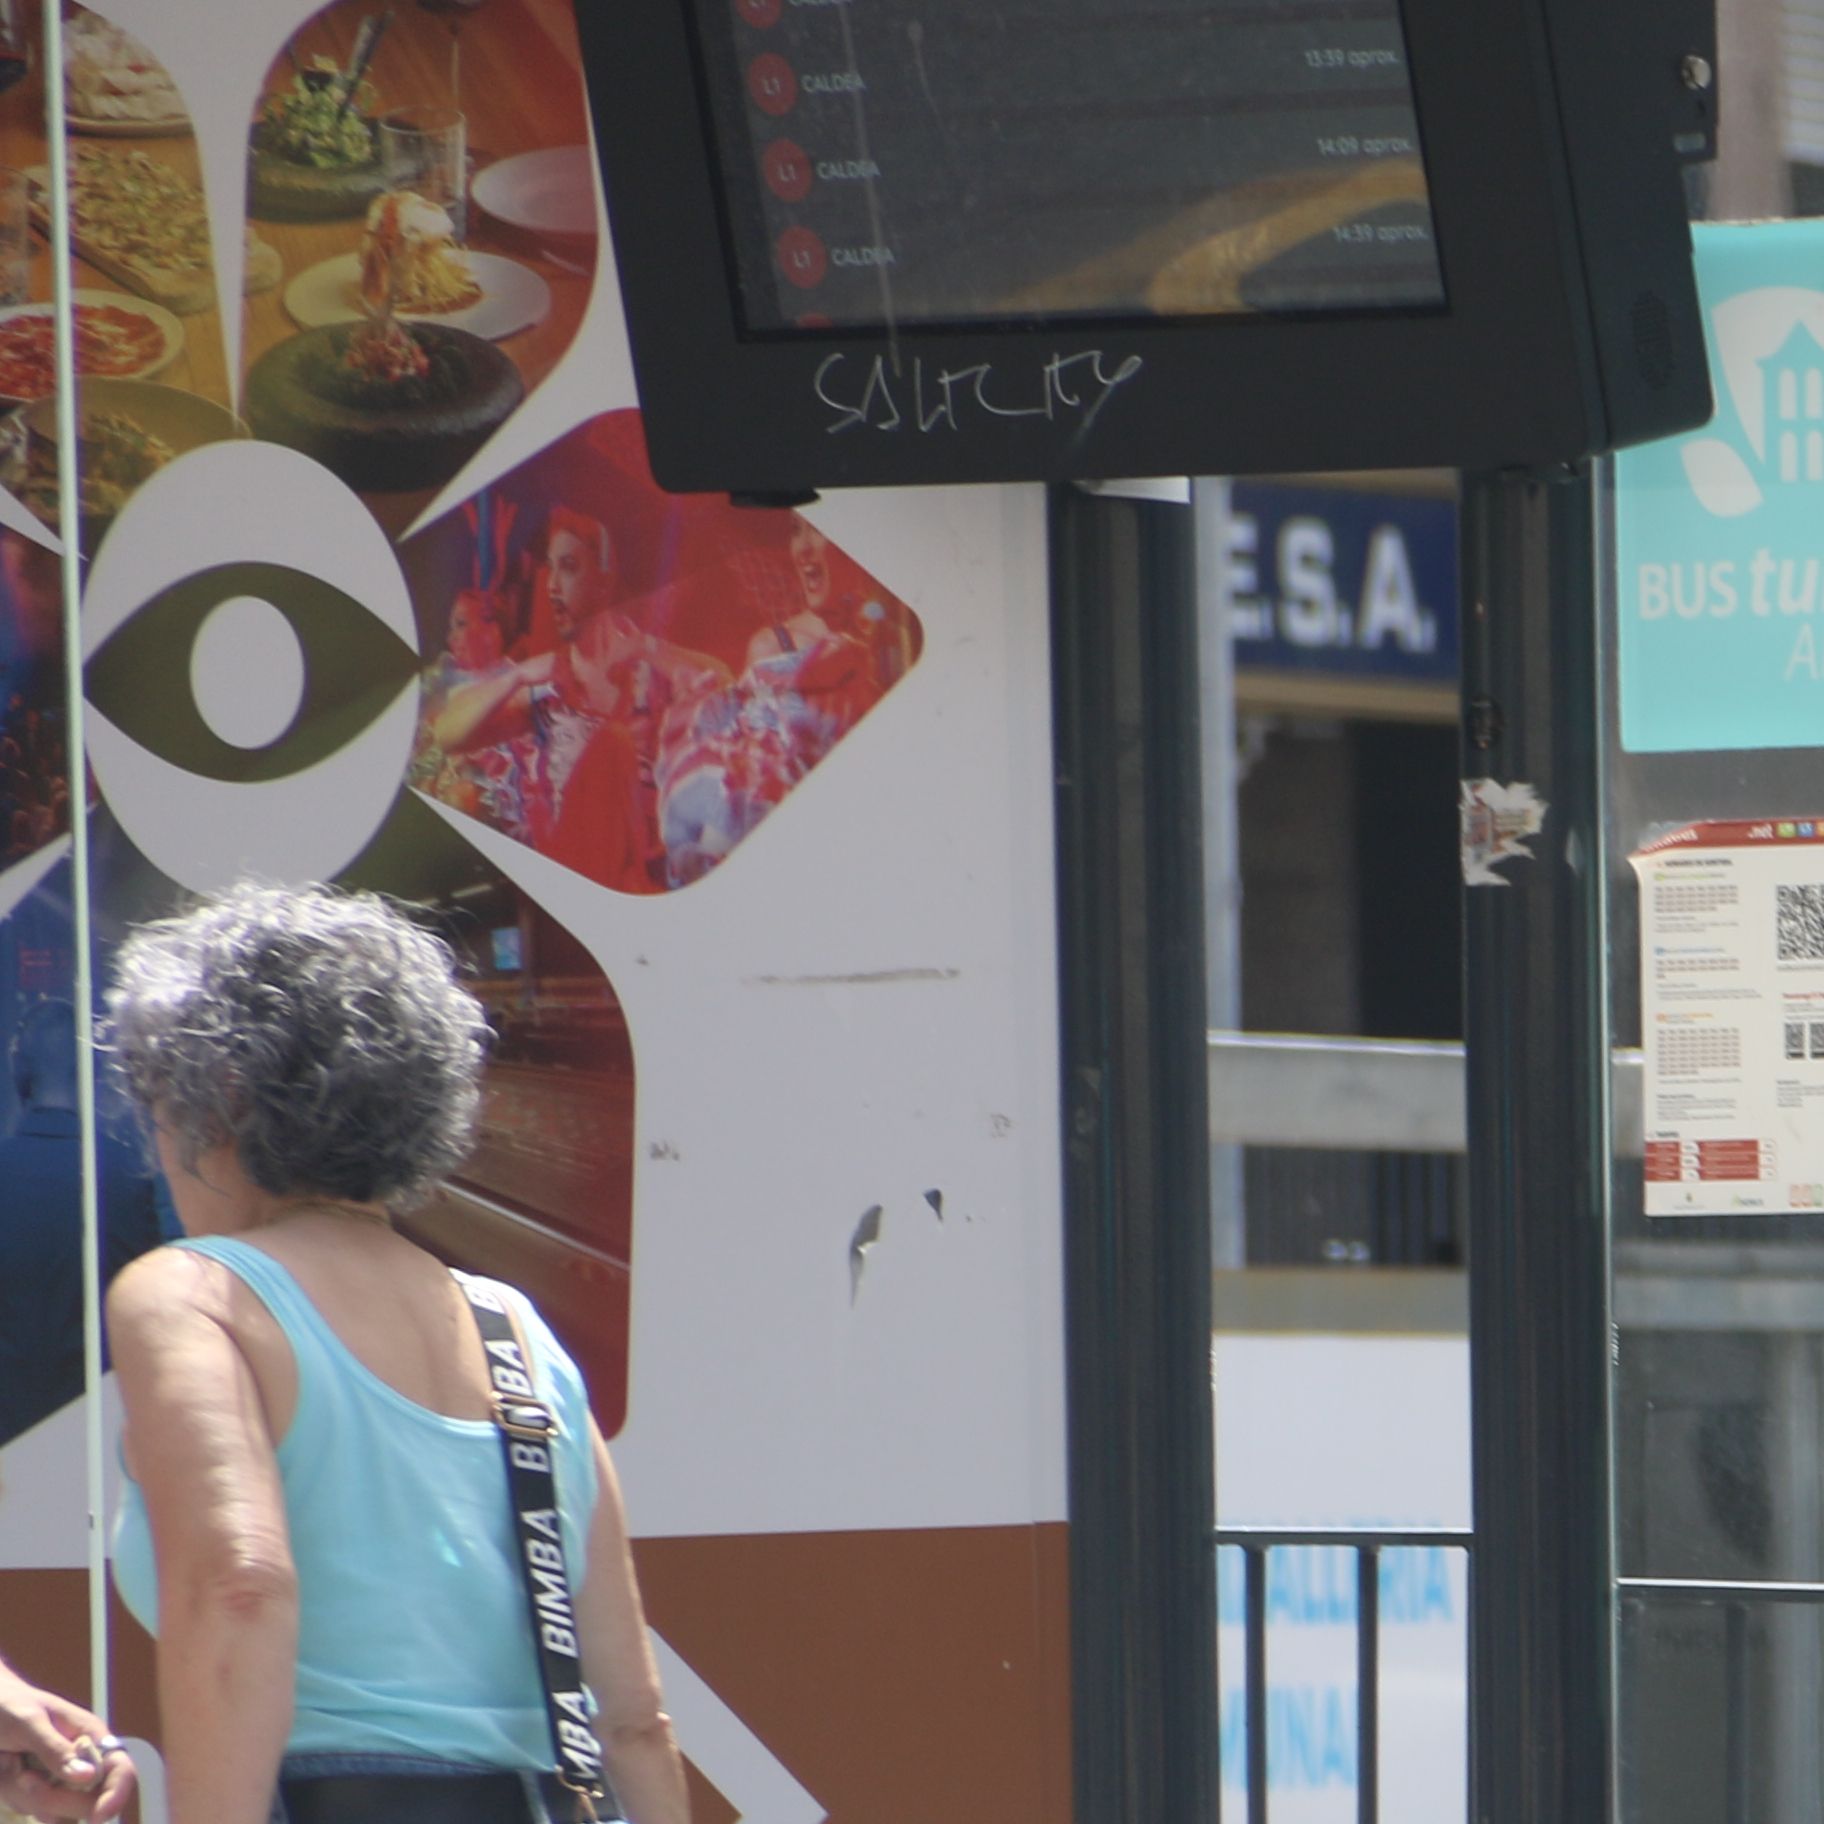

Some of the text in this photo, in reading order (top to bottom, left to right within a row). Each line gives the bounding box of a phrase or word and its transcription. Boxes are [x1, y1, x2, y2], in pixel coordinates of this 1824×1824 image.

[802, 70, 867, 92] CALDEA
[816, 160, 882, 180] CALDEA
[831, 247, 897, 267] CALDEA
[1637, 560, 1739, 621] BUS
[521, 1508, 580, 1660] BIMBA
